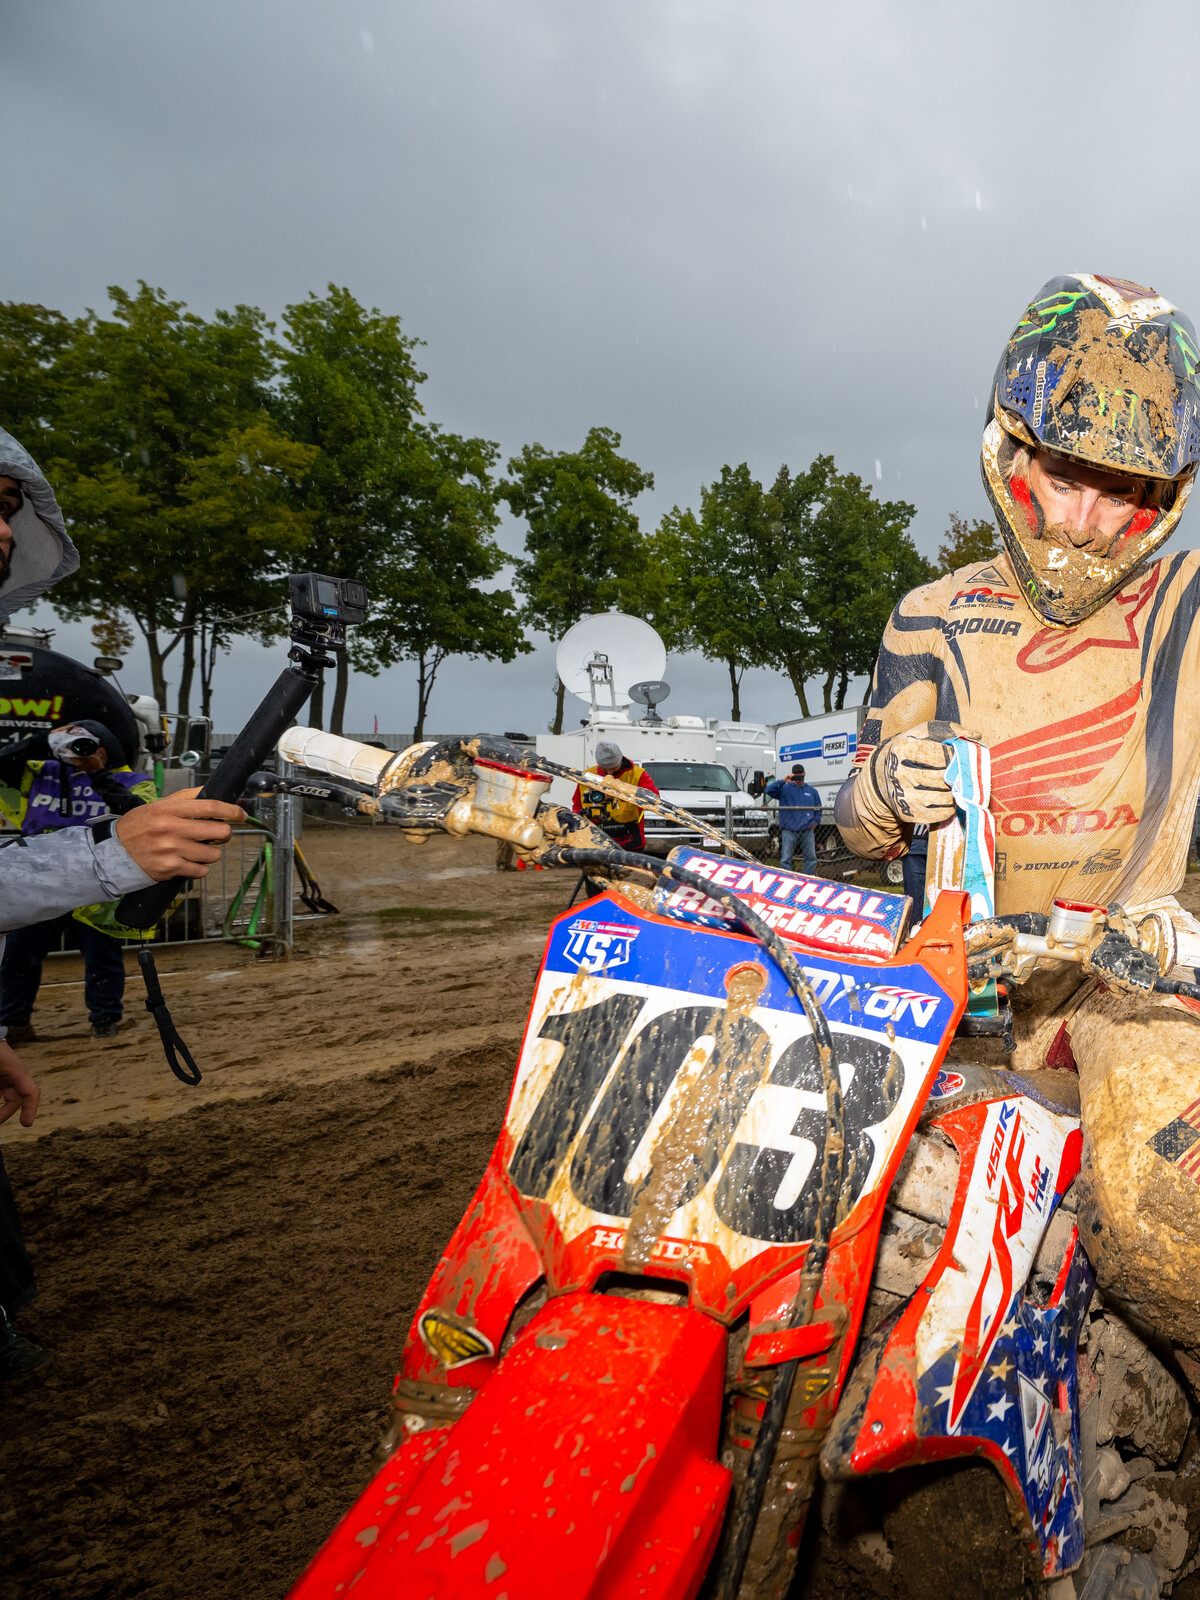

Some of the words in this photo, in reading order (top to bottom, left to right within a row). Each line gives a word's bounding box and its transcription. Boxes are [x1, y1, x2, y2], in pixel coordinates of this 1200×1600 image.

[943, 617, 1021, 640] SHOWA
[825, 741, 846, 751] PENSKE
[73, 786, 93, 797] 10
[995, 803, 1140, 838] ONDA
[1023, 860, 1079, 871] DUNLOP
[683, 856, 888, 921] RENTHAL
[568, 931, 634, 974] USA
[508, 992, 905, 1244] 103
[986, 1101, 1016, 1191] 450R
[591, 1229, 711, 1265] HDA
